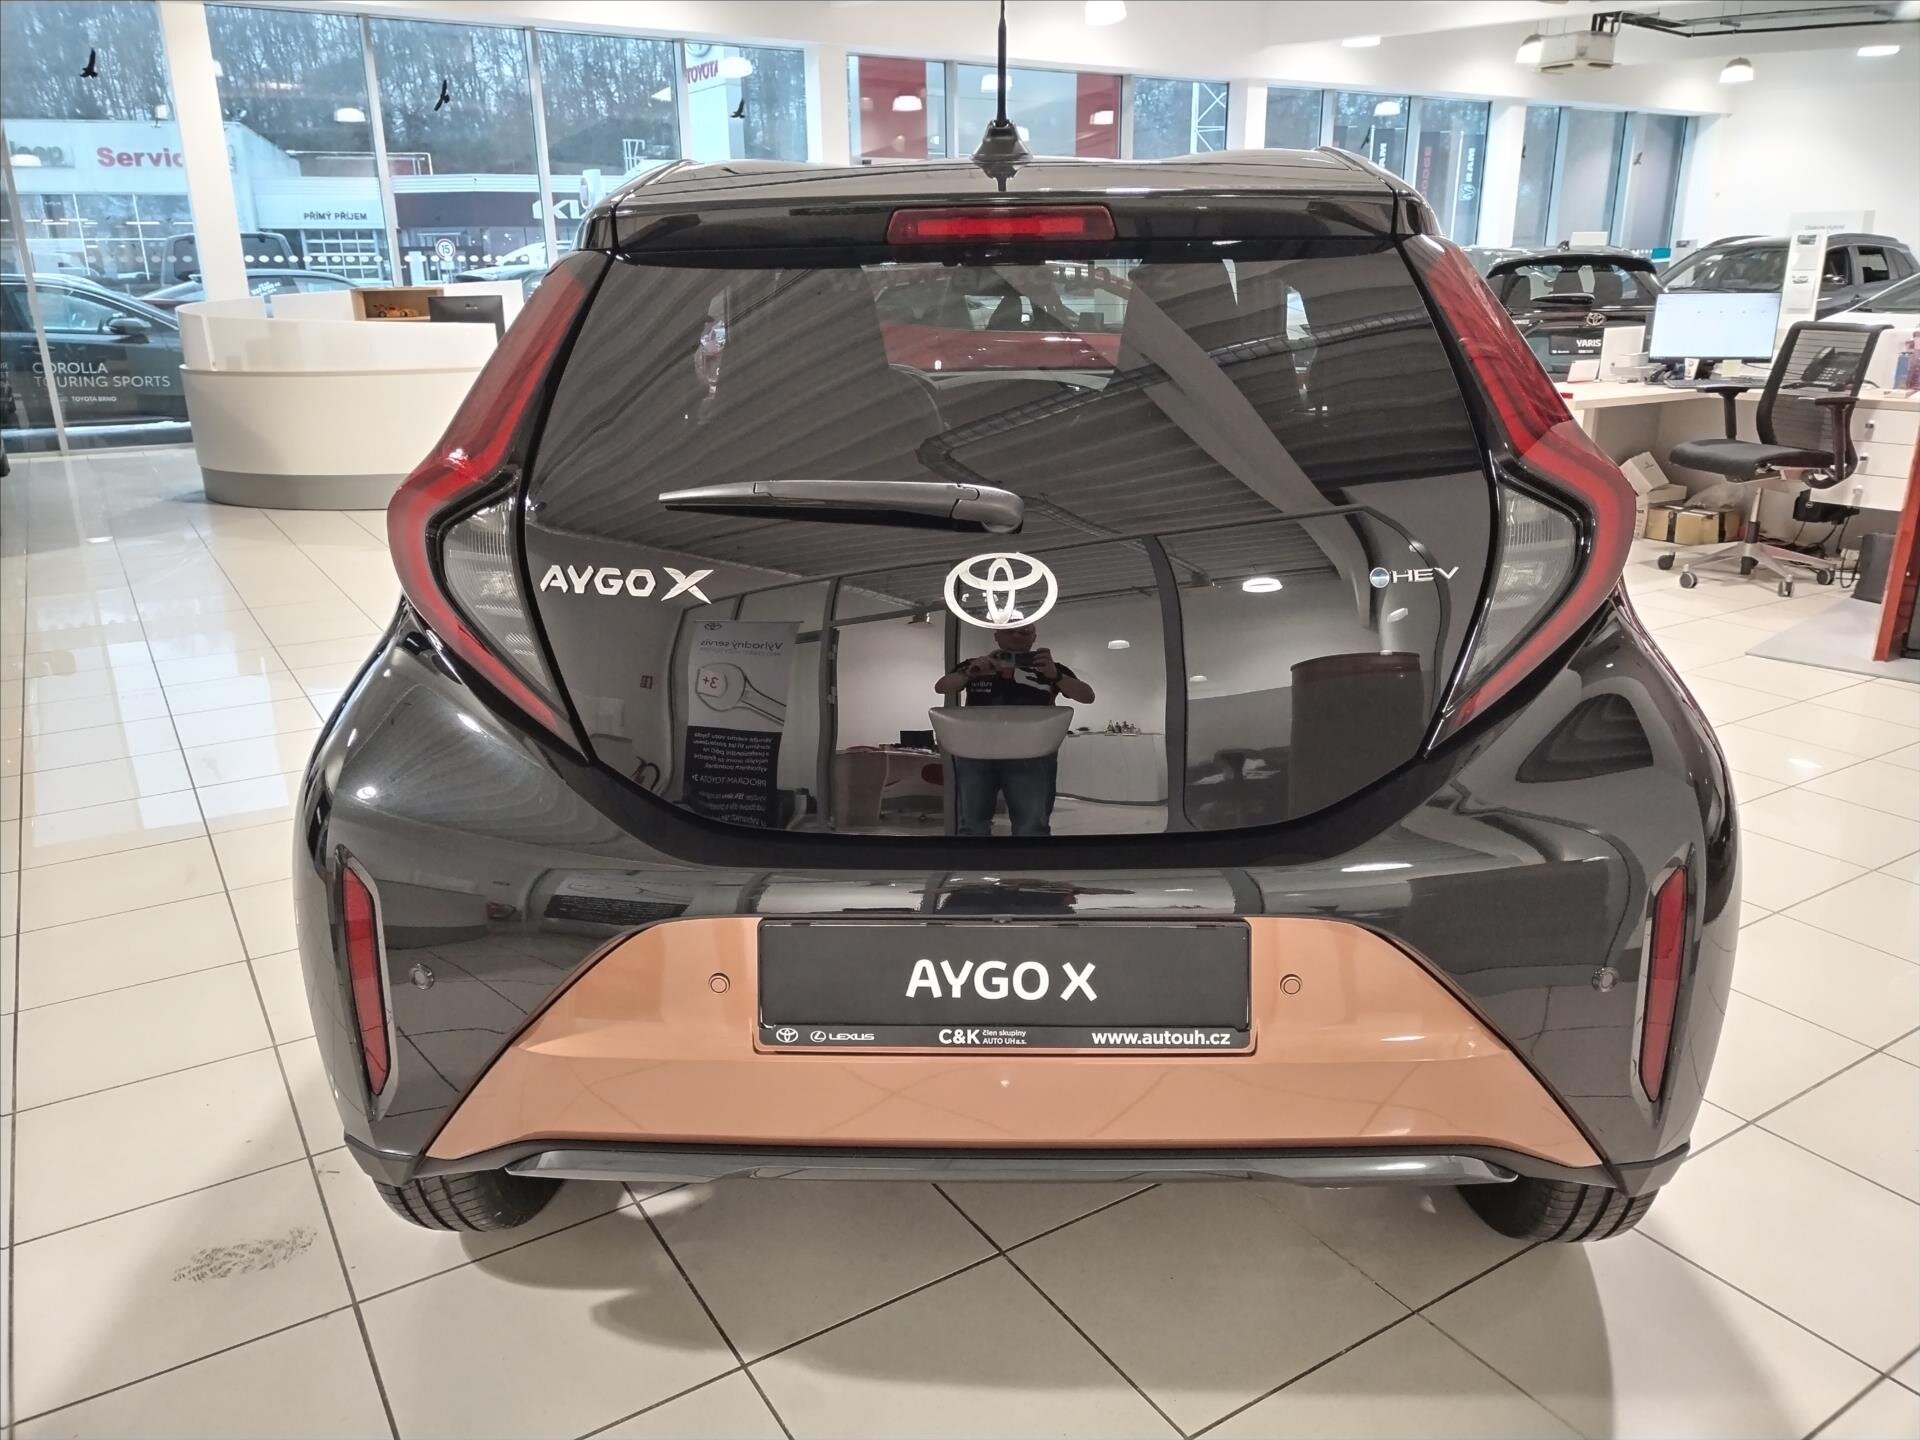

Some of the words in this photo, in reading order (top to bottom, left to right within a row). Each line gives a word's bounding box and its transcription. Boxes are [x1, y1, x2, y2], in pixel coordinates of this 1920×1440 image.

[1466, 147, 1476, 183] RAM
[441, 244, 450, 255] 15
[1576, 339, 1602, 348] YARIS
[112, 375, 171, 388] SPORTS
[1391, 566, 1460, 584] HEV
[539, 564, 657, 598] AYGO
[660, 566, 715, 605] X
[905, 959, 1050, 1001] AYGO
[1059, 961, 1098, 1002] X
[828, 1032, 875, 1041] LEXUS
[938, 1028, 981, 1045] C&K
[998, 1029, 1027, 1038] skupiny
[1091, 1030, 1231, 1045] www.autouh.cz
[982, 1037, 1003, 1045] AUTO
